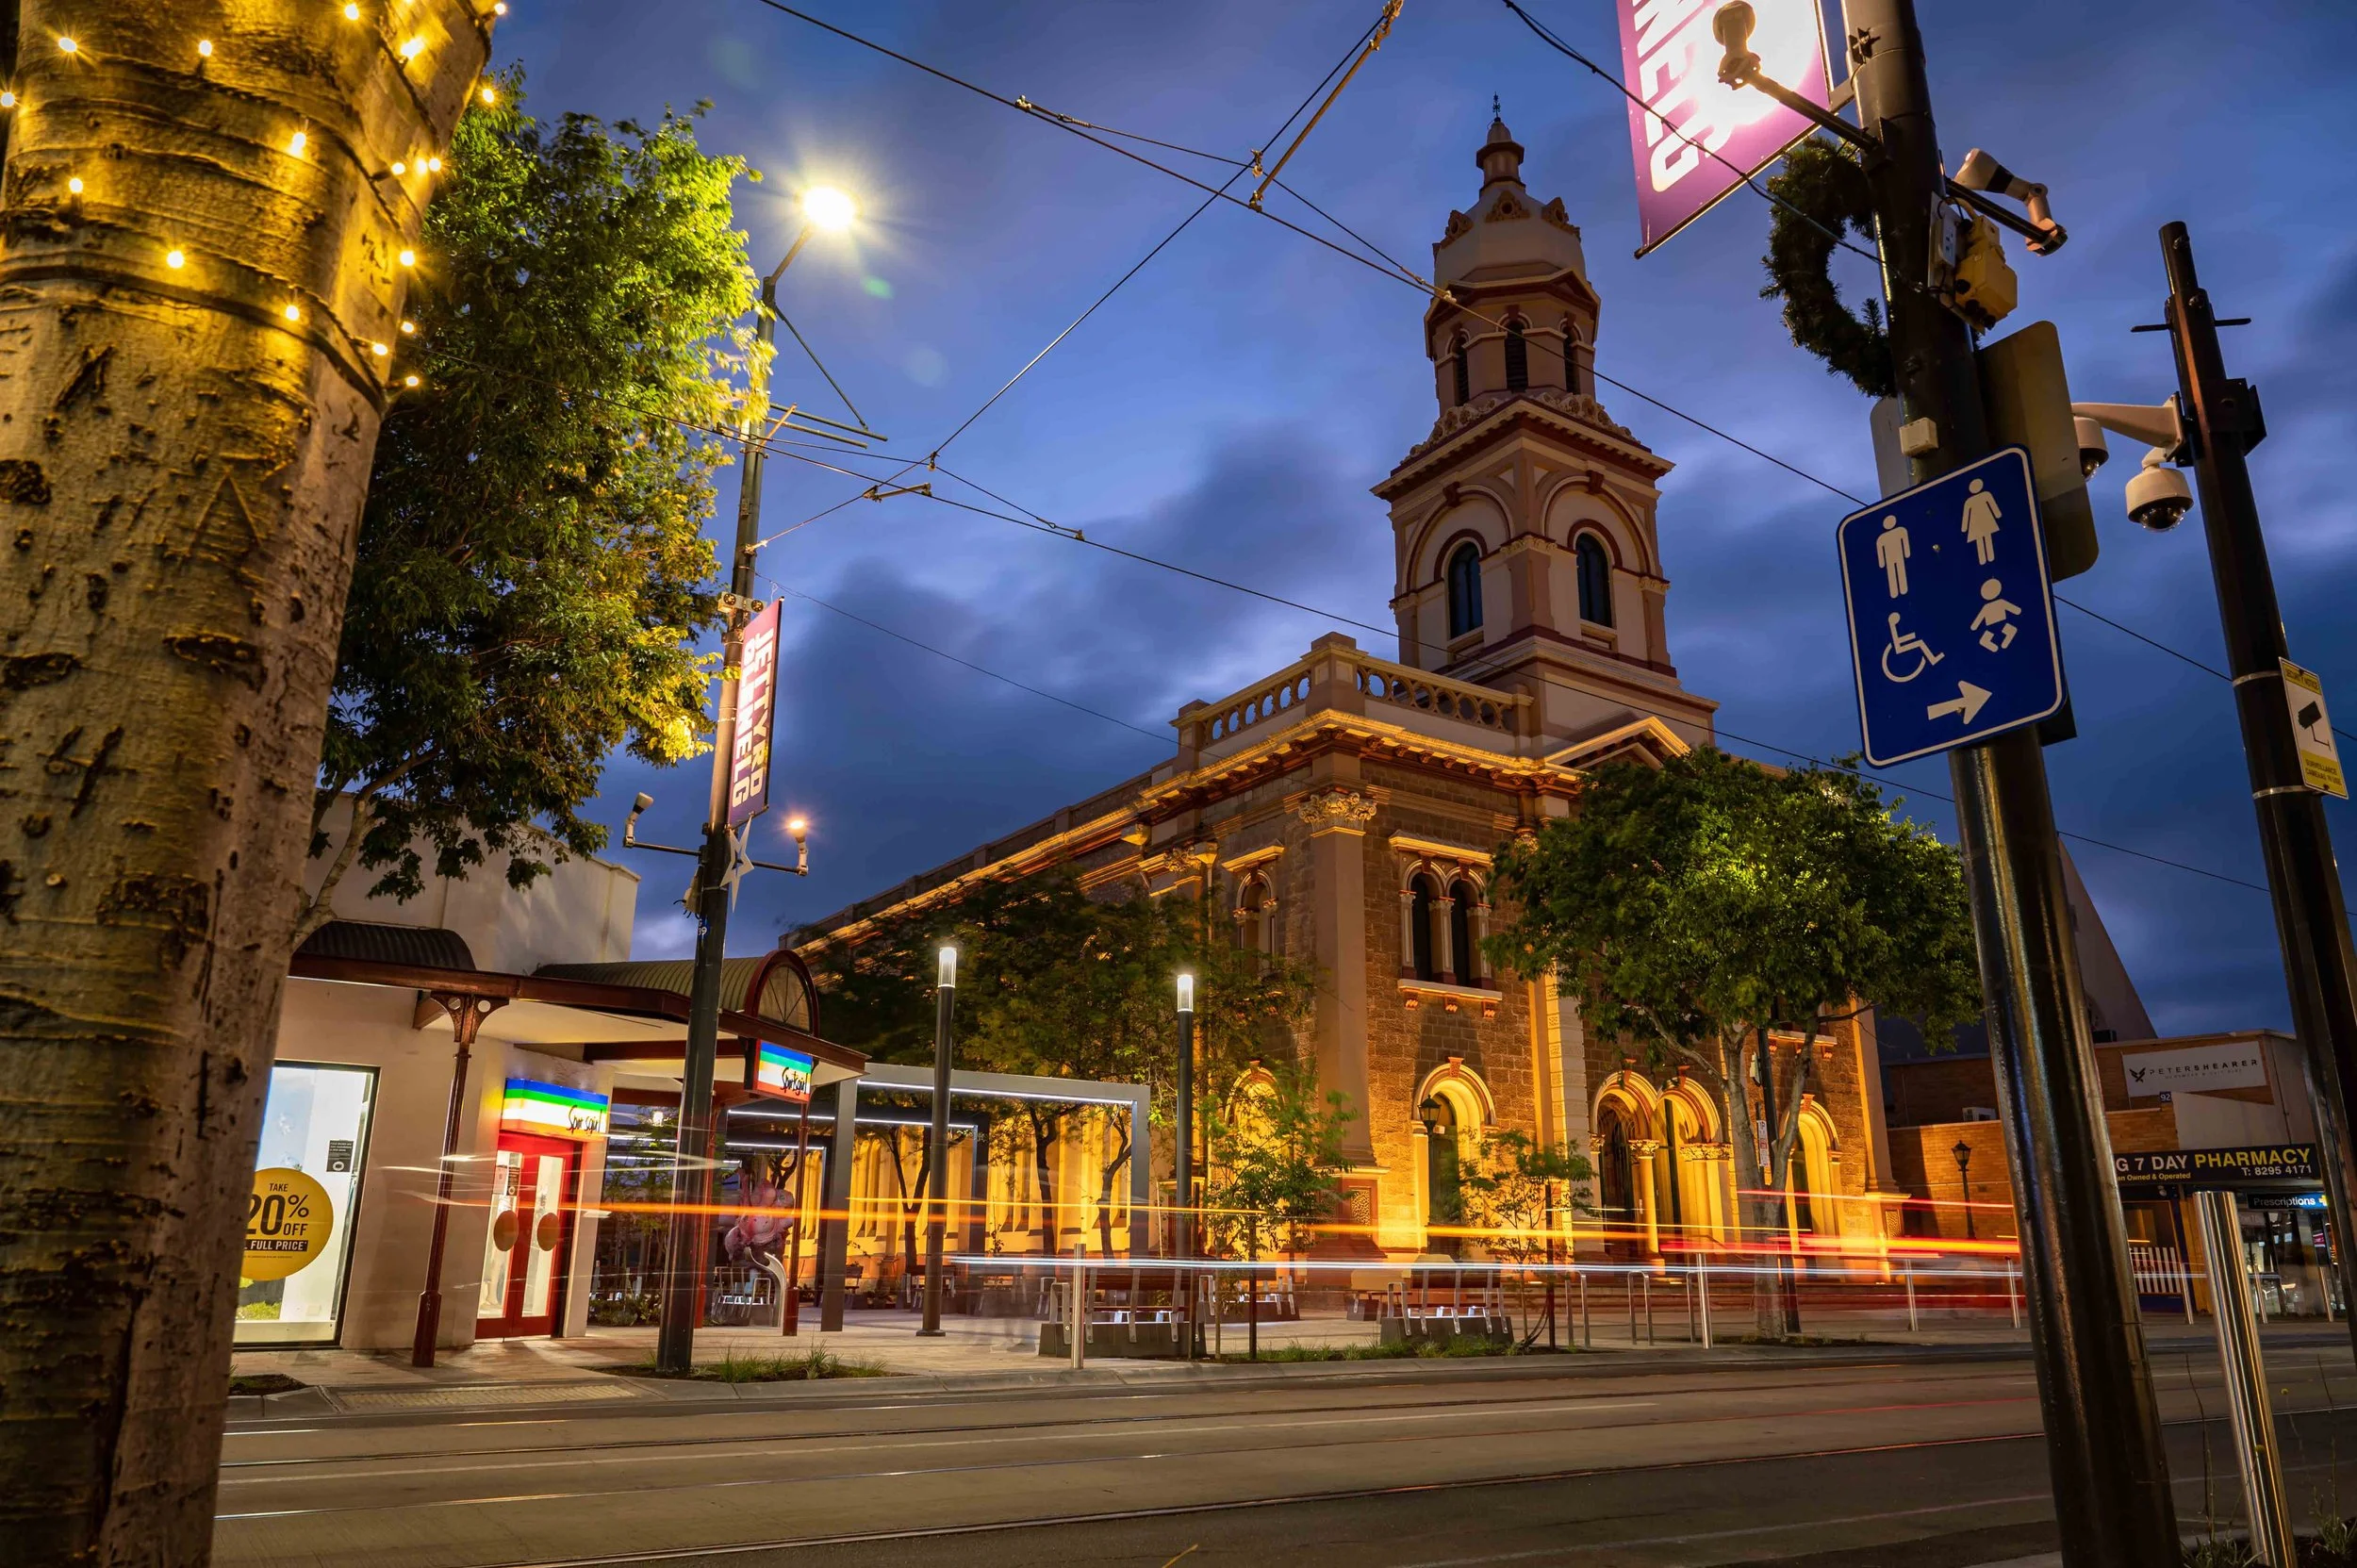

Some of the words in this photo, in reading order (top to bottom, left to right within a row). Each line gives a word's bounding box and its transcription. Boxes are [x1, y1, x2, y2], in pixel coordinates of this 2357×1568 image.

[566, 1104, 603, 1136] Sporsgirl
[2134, 1157, 2144, 1171] 7
[2151, 1154, 2187, 1170] DAY
[2194, 1147, 2310, 1168] PHARMACY
[2242, 1166, 2251, 1176] T:
[2254, 1165, 2282, 1176] 8295
[2285, 1164, 2312, 1174] 4171
[2158, 1172, 2191, 1180] Operated
[269, 1182, 288, 1192] TAKE
[2253, 1197, 2316, 1207] Prescriptions
[283, 1223, 308, 1236] OFF
[250, 1240, 272, 1250] FULL
